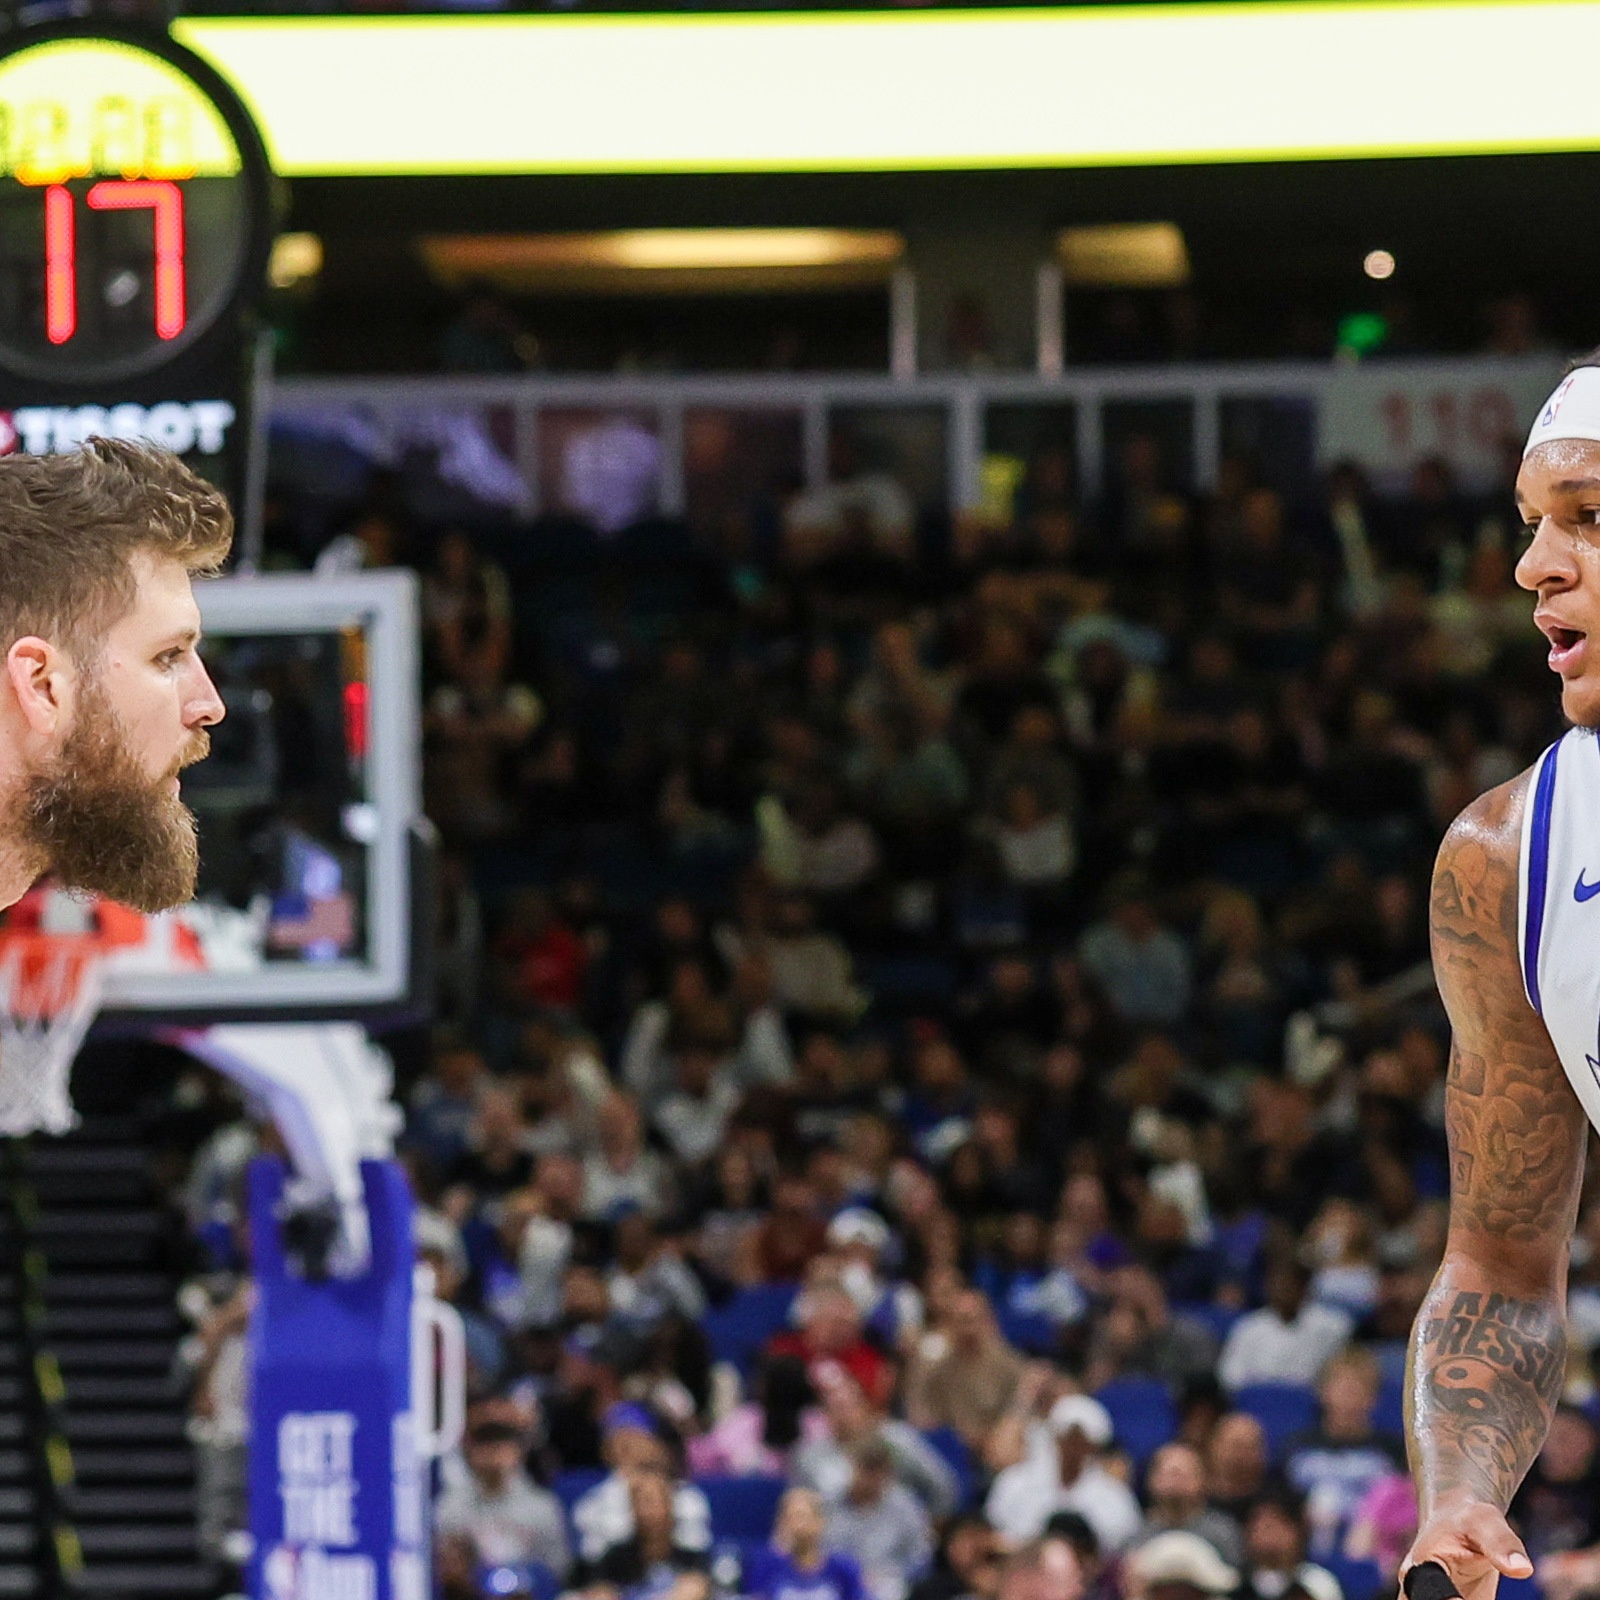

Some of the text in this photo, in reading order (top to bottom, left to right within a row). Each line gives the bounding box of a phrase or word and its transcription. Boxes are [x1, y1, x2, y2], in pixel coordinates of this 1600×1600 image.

[45, 180, 186, 344] 17
[278, 1412, 357, 1476] GET
[278, 1479, 360, 1546] THE
